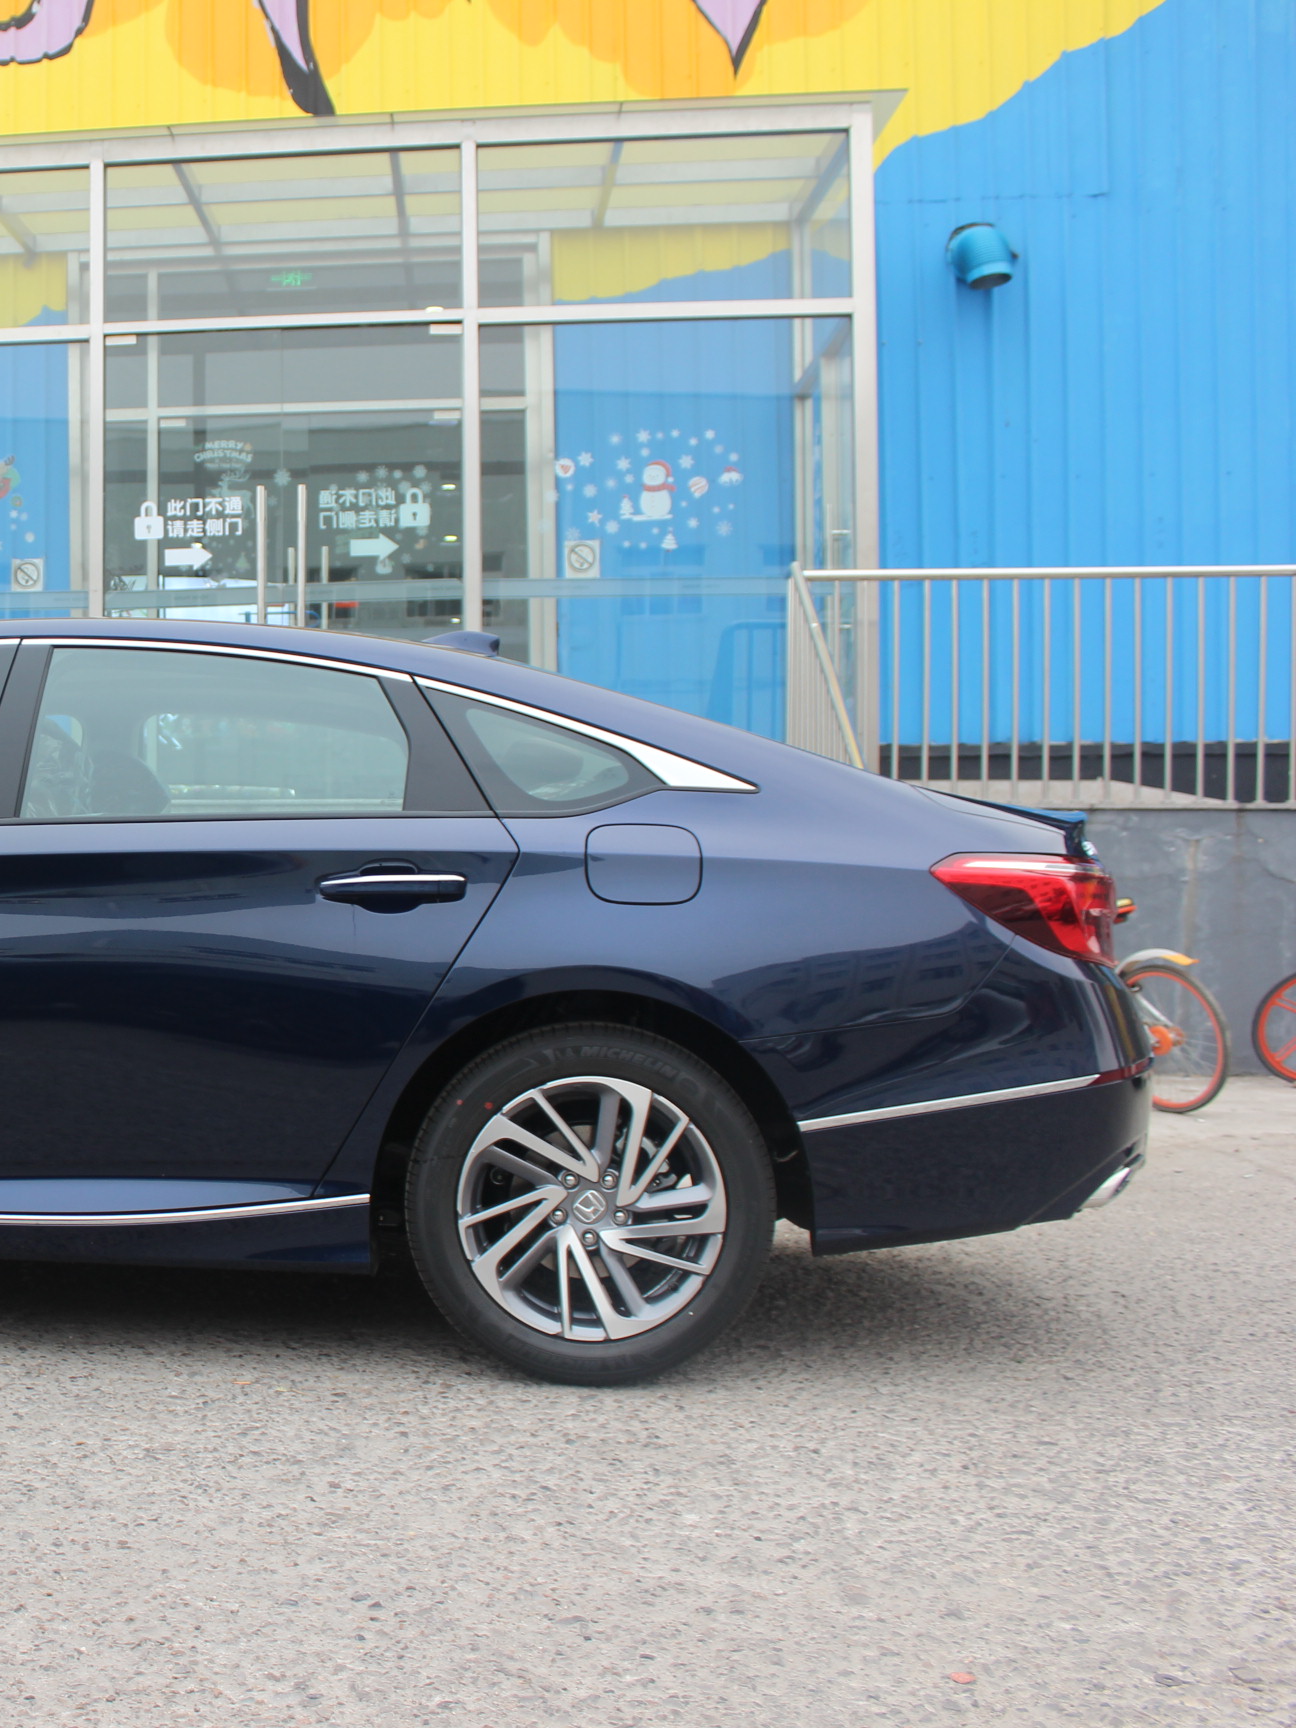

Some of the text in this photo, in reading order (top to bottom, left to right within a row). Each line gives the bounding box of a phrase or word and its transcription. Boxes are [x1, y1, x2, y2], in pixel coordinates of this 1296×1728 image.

[167, 497, 243, 517] 此门不通
[167, 518, 243, 538] 请走侧门
